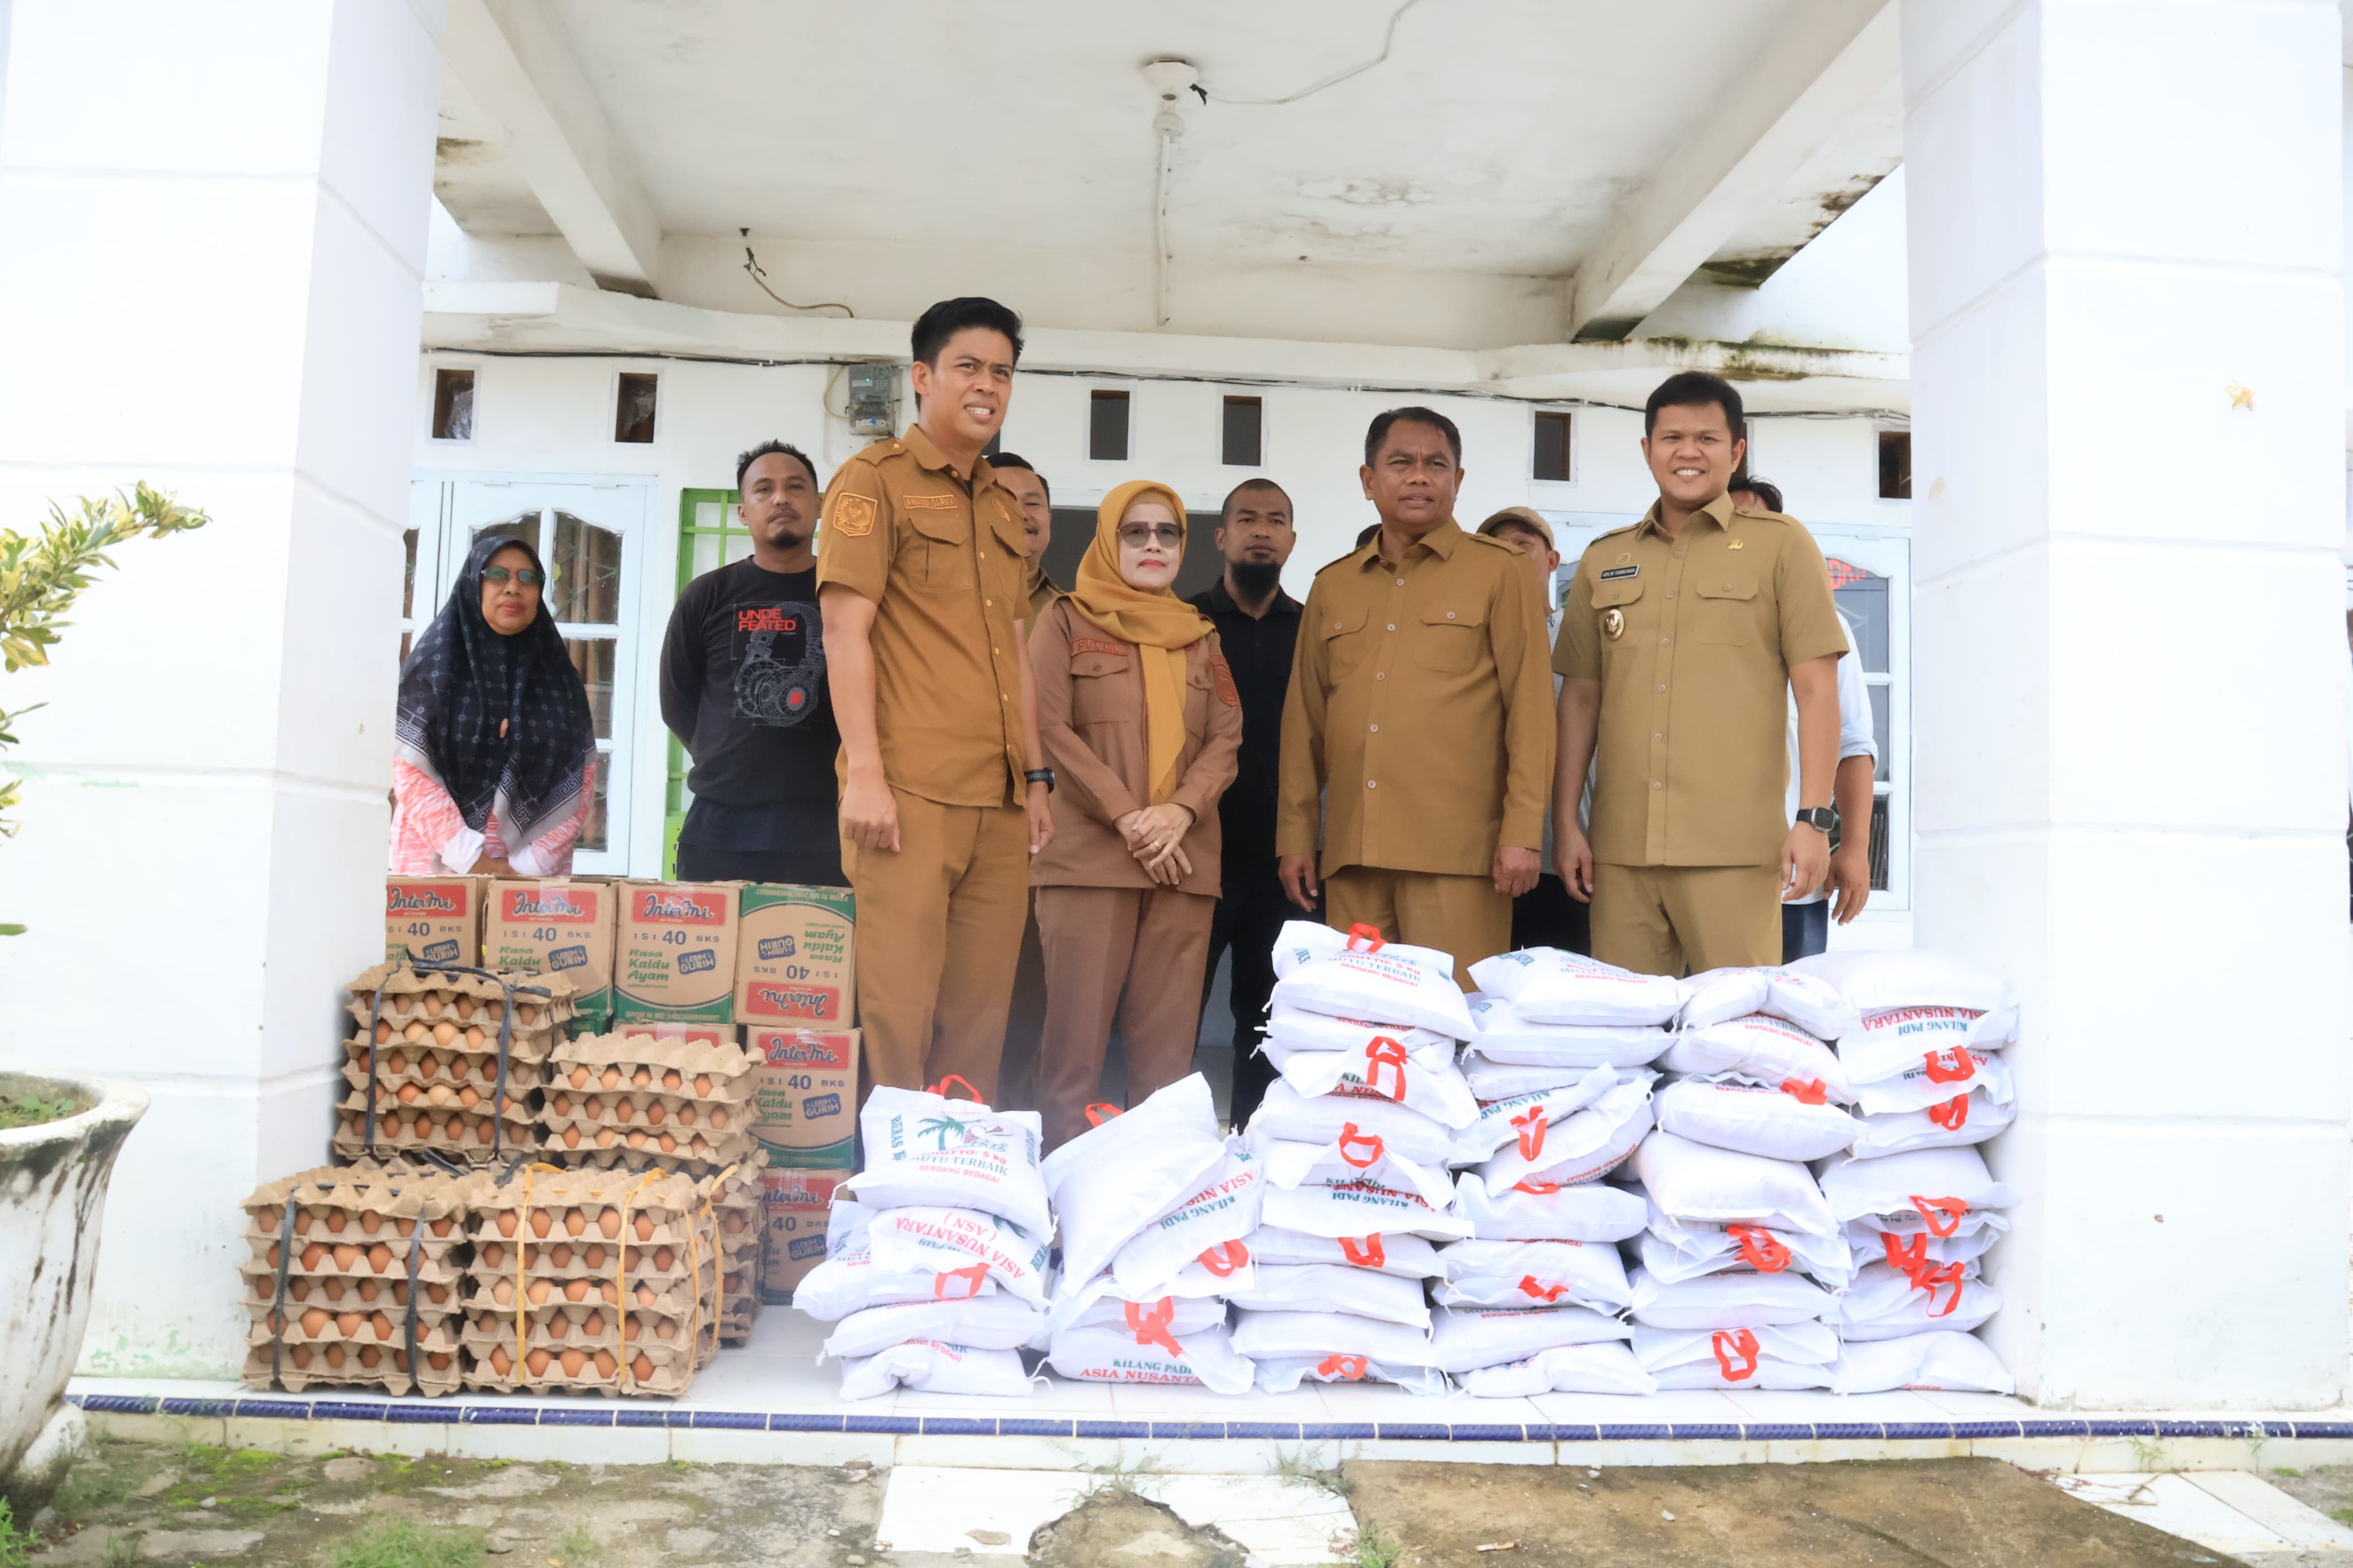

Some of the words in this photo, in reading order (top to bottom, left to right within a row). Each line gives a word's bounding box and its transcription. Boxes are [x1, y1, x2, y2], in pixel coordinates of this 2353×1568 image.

[738, 608, 783, 621] UNDE
[738, 619, 796, 632] FEATED
[407, 922, 430, 936] 40
[533, 927, 557, 941] 40
[662, 931, 687, 945] 40
[804, 930, 845, 943] Ayam
[760, 938, 793, 951] GURIH
[803, 941, 844, 954] Kaldu
[499, 956, 540, 966] Kaldu
[551, 954, 585, 969] GURIH
[628, 958, 670, 970] Kaldu
[680, 958, 714, 972] GURIH
[809, 954, 843, 964] Rasa
[627, 970, 669, 982] Ayam
[754, 966, 777, 974] BKS
[786, 965, 809, 980] 40
[1341, 962, 1380, 975] SERDANG
[1382, 972, 1418, 987] BEDAGAI
[1369, 961, 1421, 982] TERBAIK
[1861, 1007, 1955, 1032] NUSANTARA
[1927, 1020, 1968, 1032] KILANG
[1898, 1022, 1923, 1036] PADI
[788, 1075, 812, 1090] 40
[1503, 1091, 1551, 1110] KILANG
[805, 1103, 839, 1117] GURIH
[952, 1156, 1010, 1176] TERBAIK
[993, 1154, 1007, 1165] kg
[918, 1164, 960, 1174] SERDANG
[963, 1168, 1000, 1184] BEDAGAI
[1219, 1169, 1253, 1194] ASIA
[1332, 1191, 1360, 1202] PADI
[1190, 1196, 1235, 1217] KILANG
[773, 1216, 796, 1231] 40
[1160, 1212, 1189, 1230] PADI
[896, 1217, 990, 1256] NUSANTARA
[991, 1250, 1025, 1279] ASIA
[1113, 1358, 1161, 1371] KILANG
[1079, 1368, 1119, 1379] ASIA
